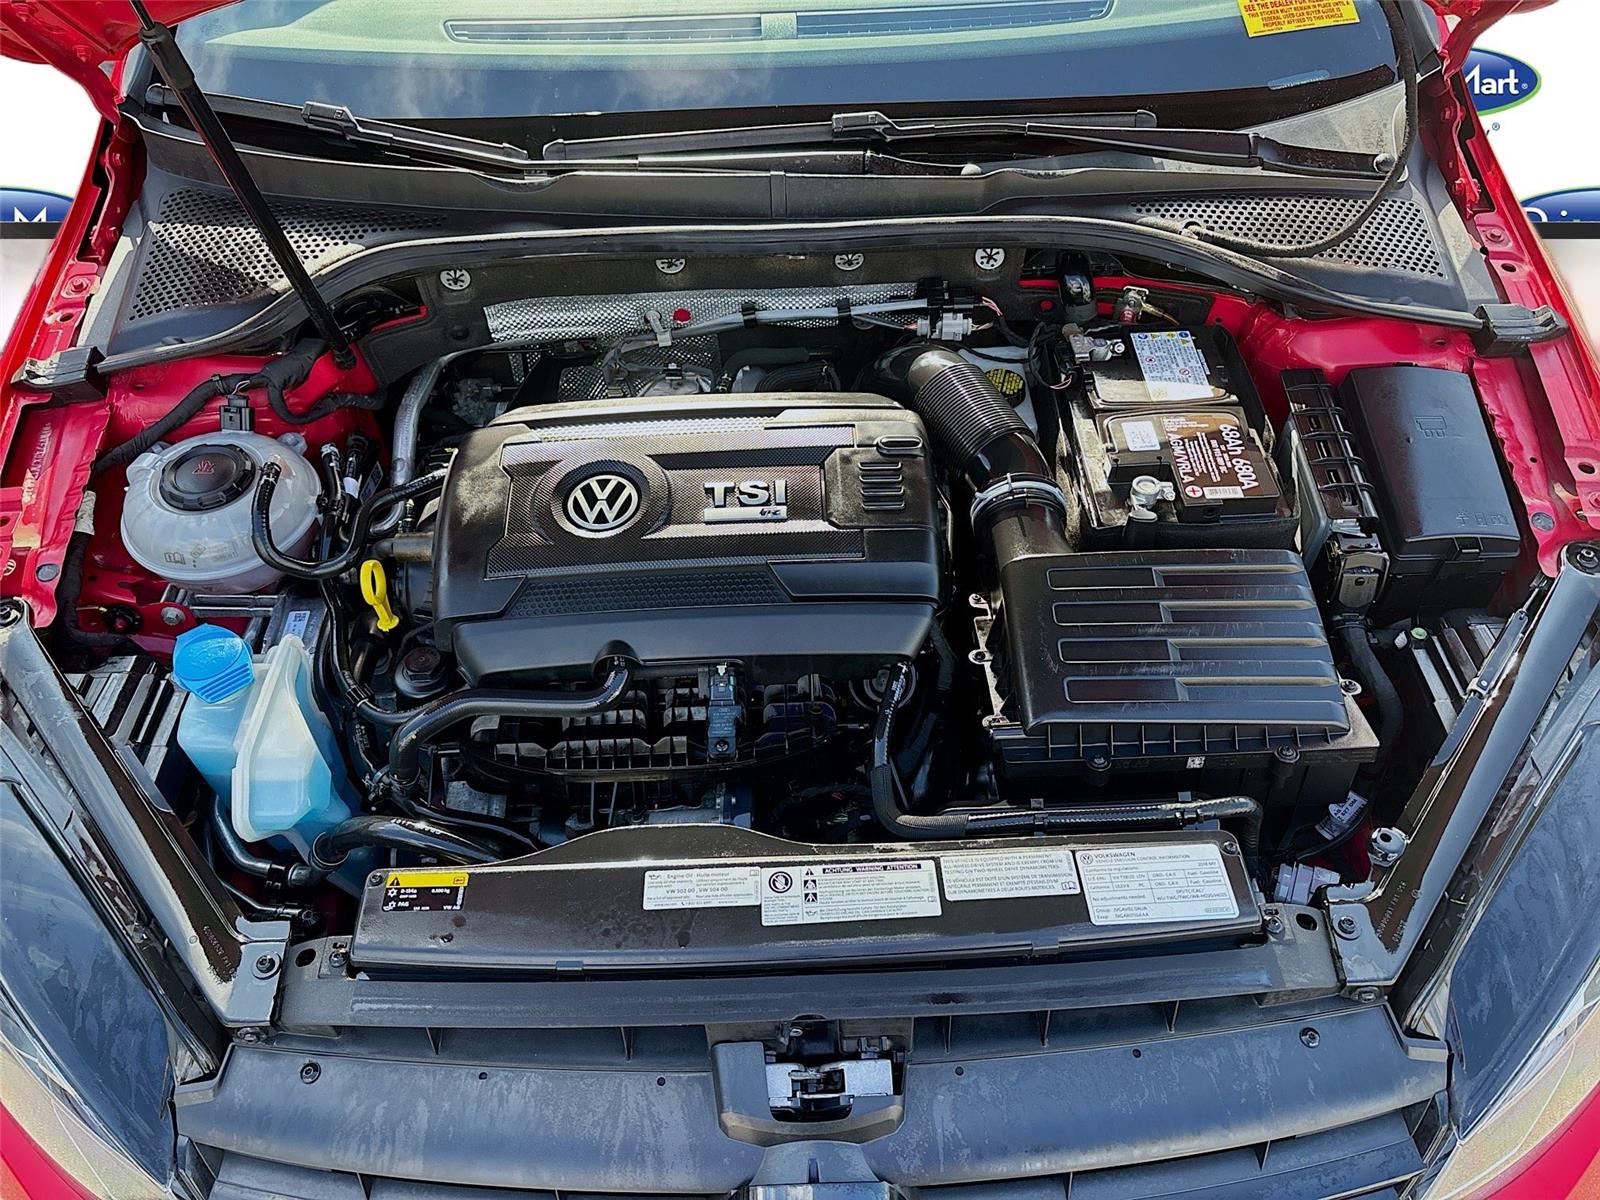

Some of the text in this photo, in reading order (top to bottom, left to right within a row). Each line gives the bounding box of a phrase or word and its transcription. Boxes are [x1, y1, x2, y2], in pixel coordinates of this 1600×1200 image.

[1244, 4, 1256, 12] SEE
[1256, 1, 1269, 10] THE
[1268, 0, 1294, 8] DEALER
[1262, 20, 1286, 28] PROPERLY
[1167, 432, 1195, 484] AGM/VRLA
[1219, 423, 1243, 456] 68Ah
[1231, 457, 1259, 490] 680A
[704, 480, 788, 507] TSI
[886, 863, 918, 871] ATTENTION
